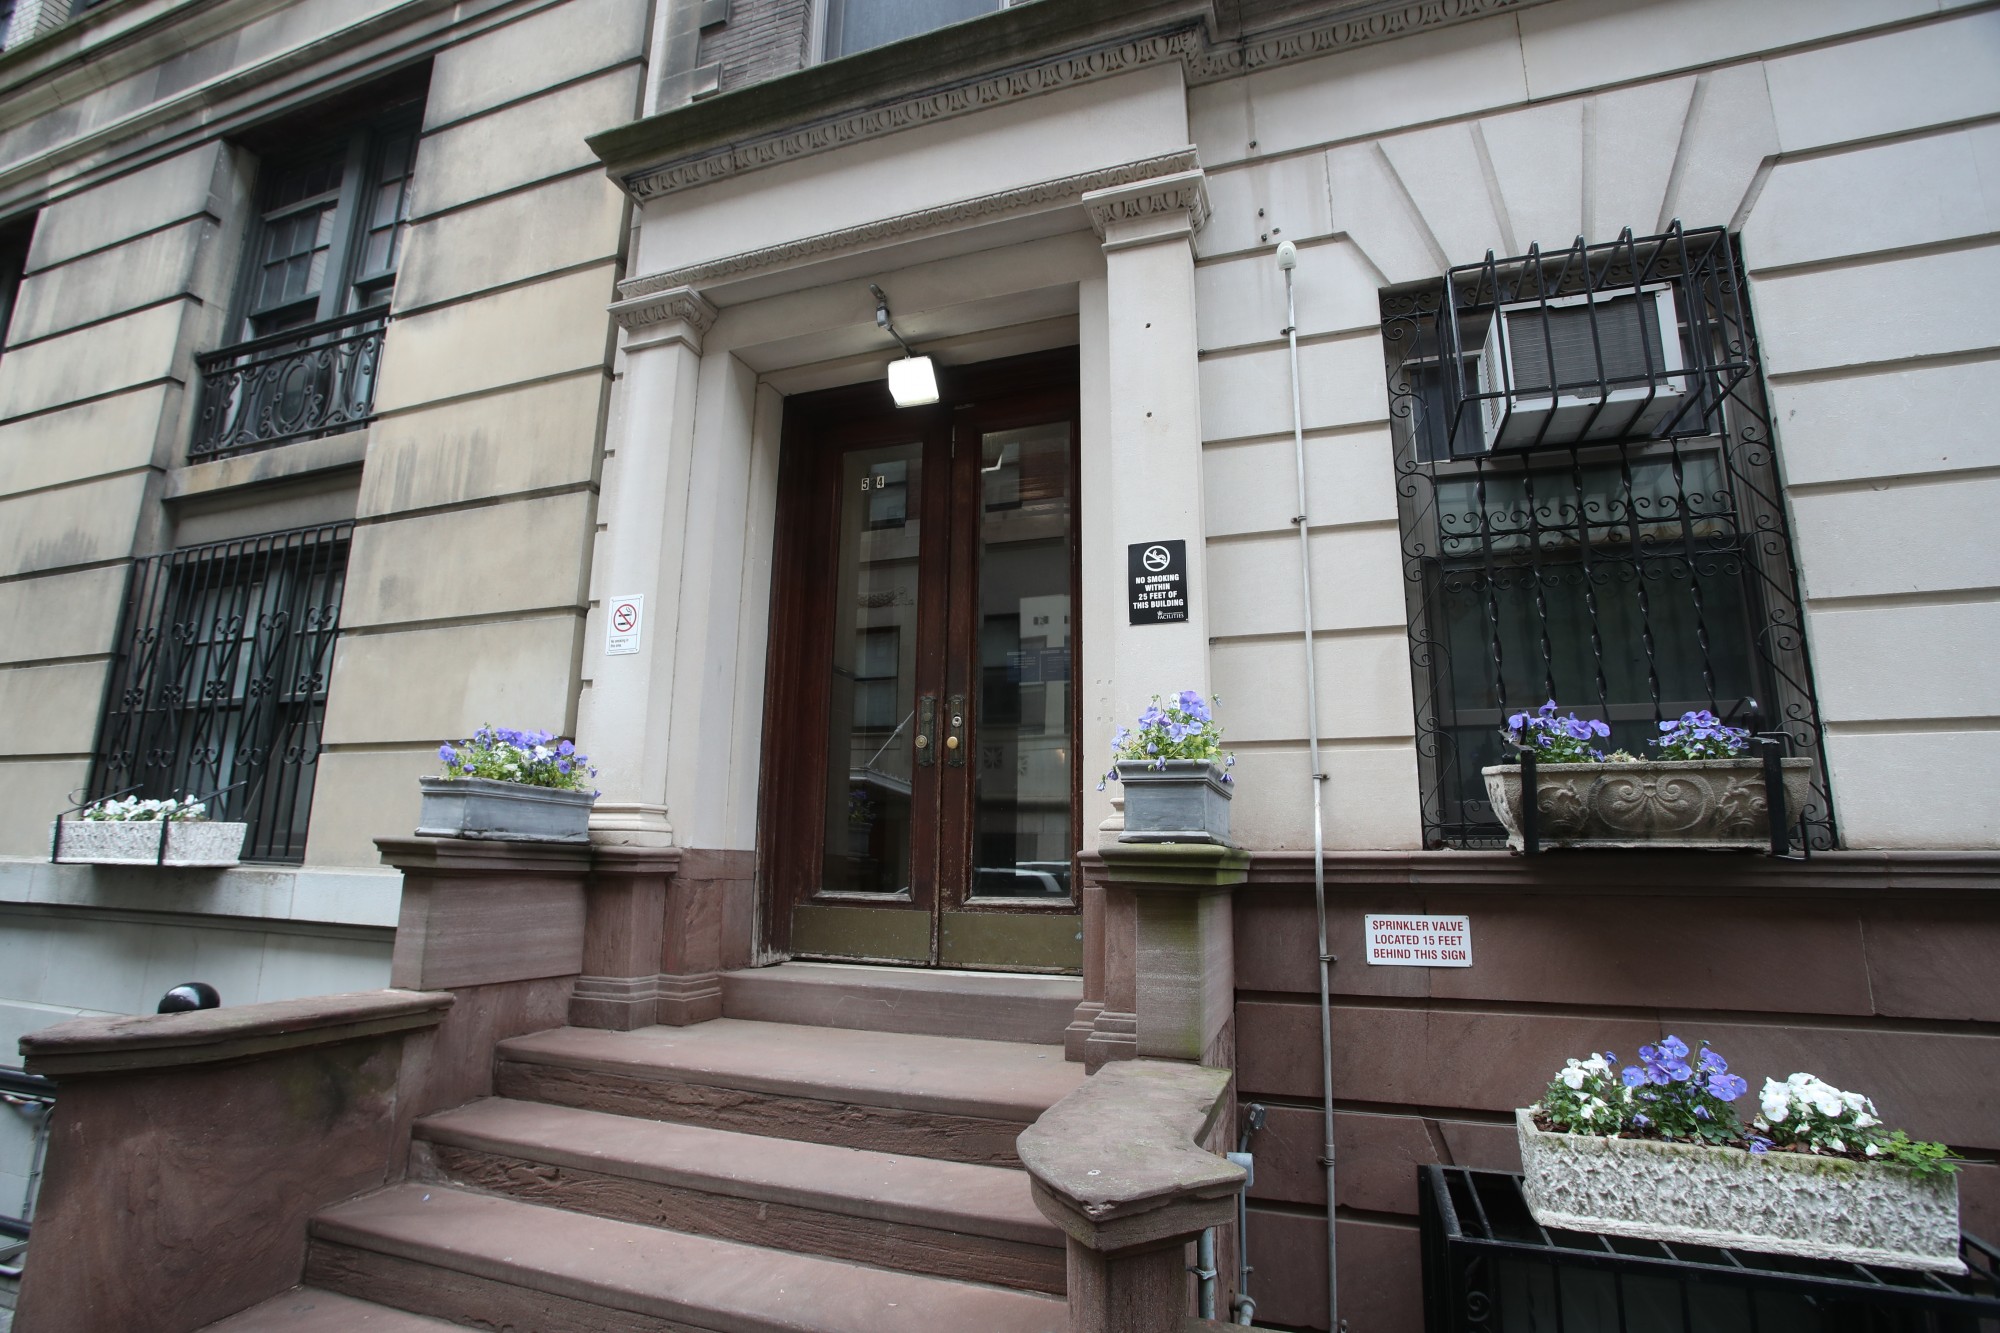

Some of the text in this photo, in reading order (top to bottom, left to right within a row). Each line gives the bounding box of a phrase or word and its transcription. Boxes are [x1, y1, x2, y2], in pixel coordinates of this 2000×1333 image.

[1147, 574, 1180, 583] SMOKING
[1144, 583, 1170, 592] WITHIN
[1150, 592, 1166, 600] FEET
[1168, 590, 1178, 598] OF
[1132, 598, 1184, 610] THIS BUILDING
[1372, 920, 1464, 932] SPRINKLER VALVE
[1375, 934, 1462, 946] LOCATED 15 FEET
[1374, 948, 1466, 960] BEHIND THIS SIGN
